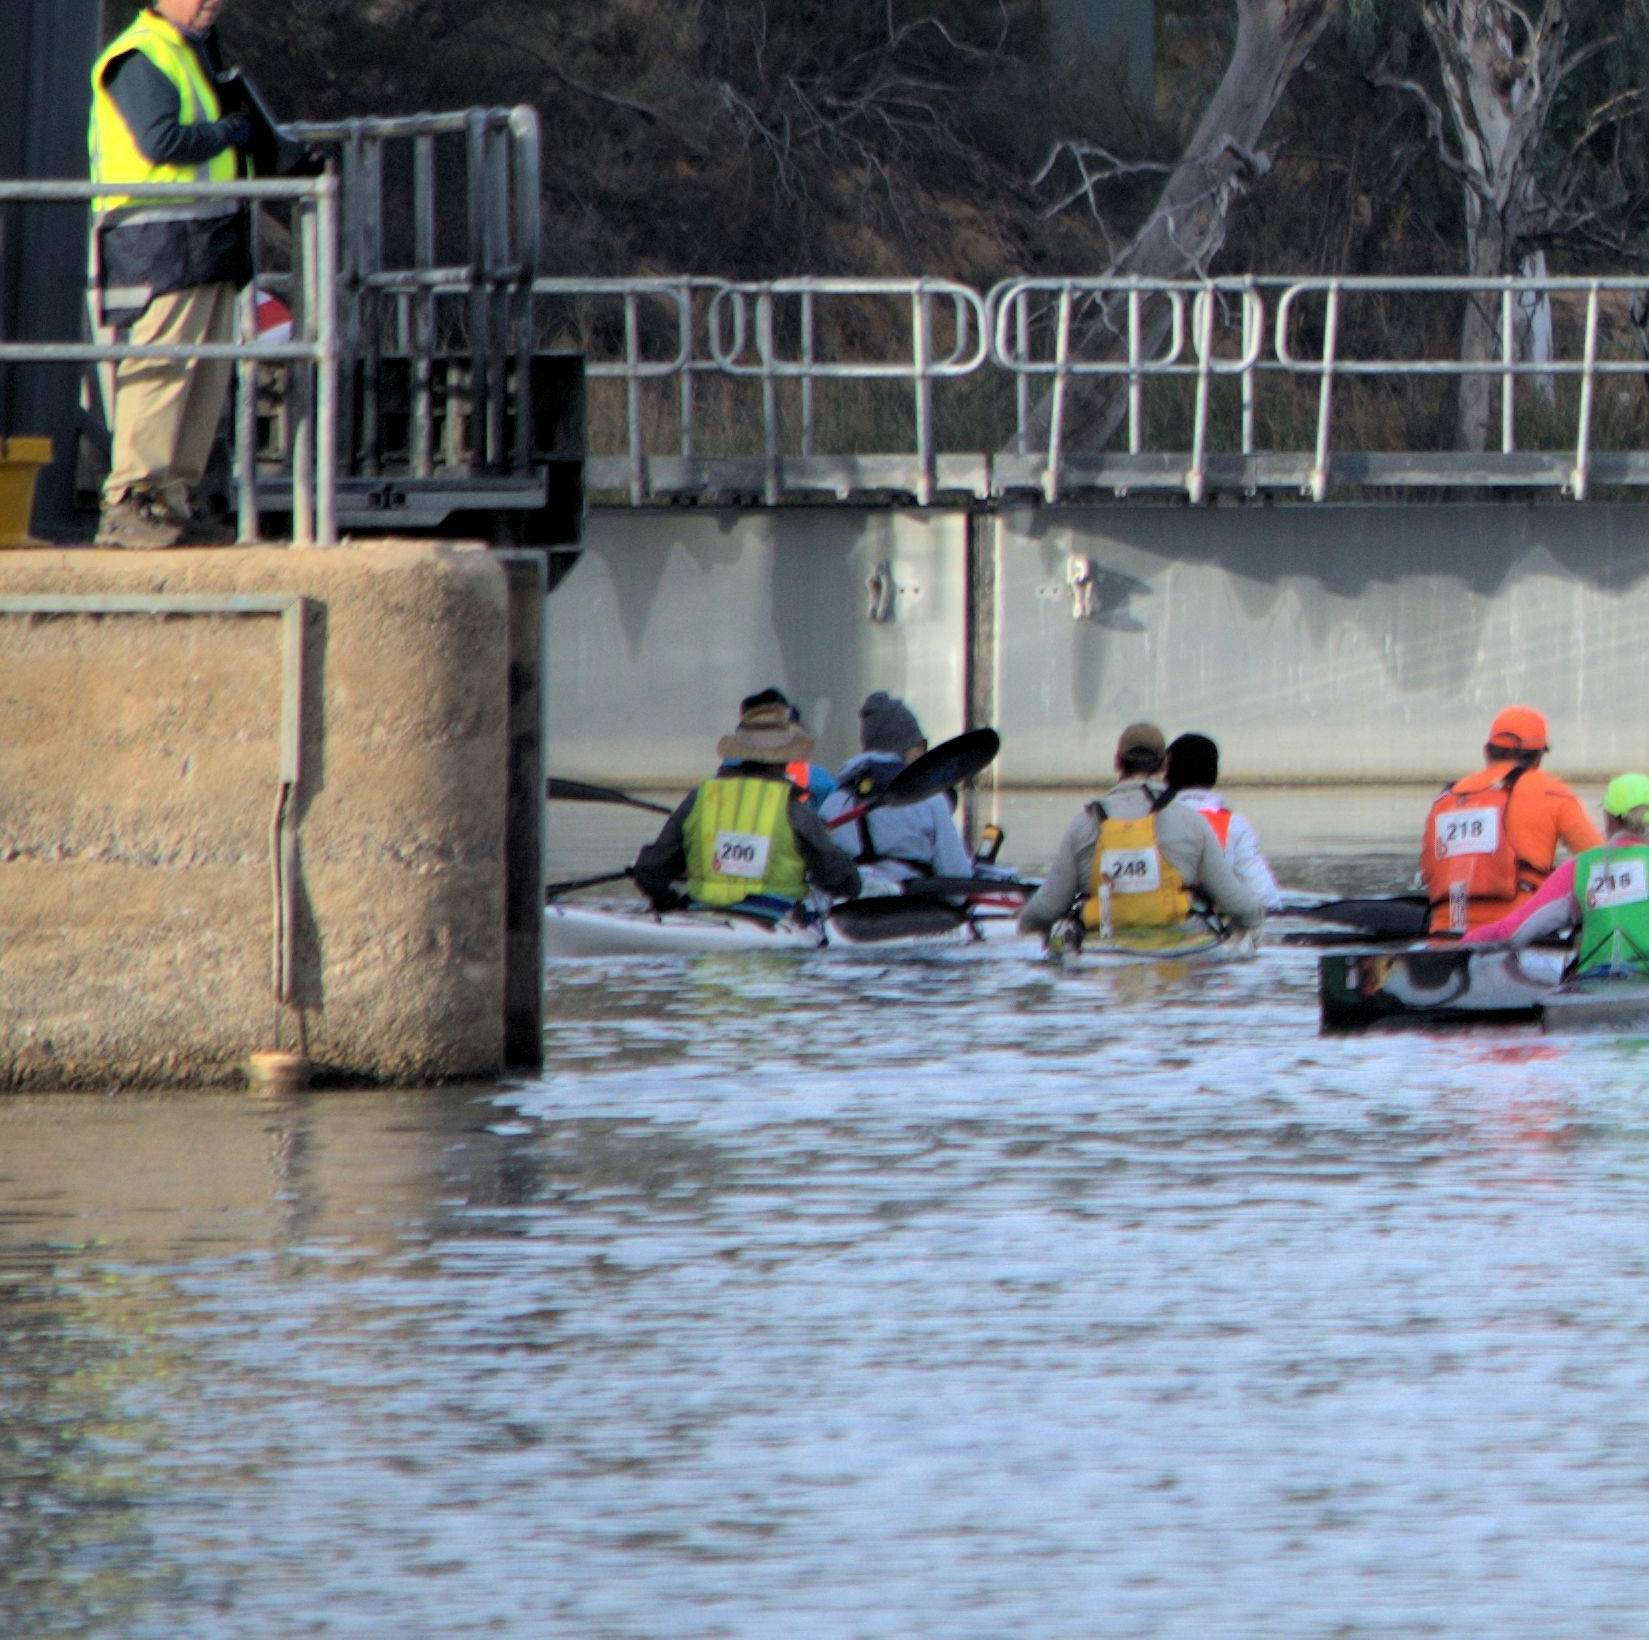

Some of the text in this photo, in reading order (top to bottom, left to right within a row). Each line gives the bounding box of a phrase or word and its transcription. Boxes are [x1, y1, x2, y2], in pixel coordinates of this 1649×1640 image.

[1446, 820, 1483, 841] 218
[720, 842, 755, 862] 200
[1112, 860, 1148, 878] 248
